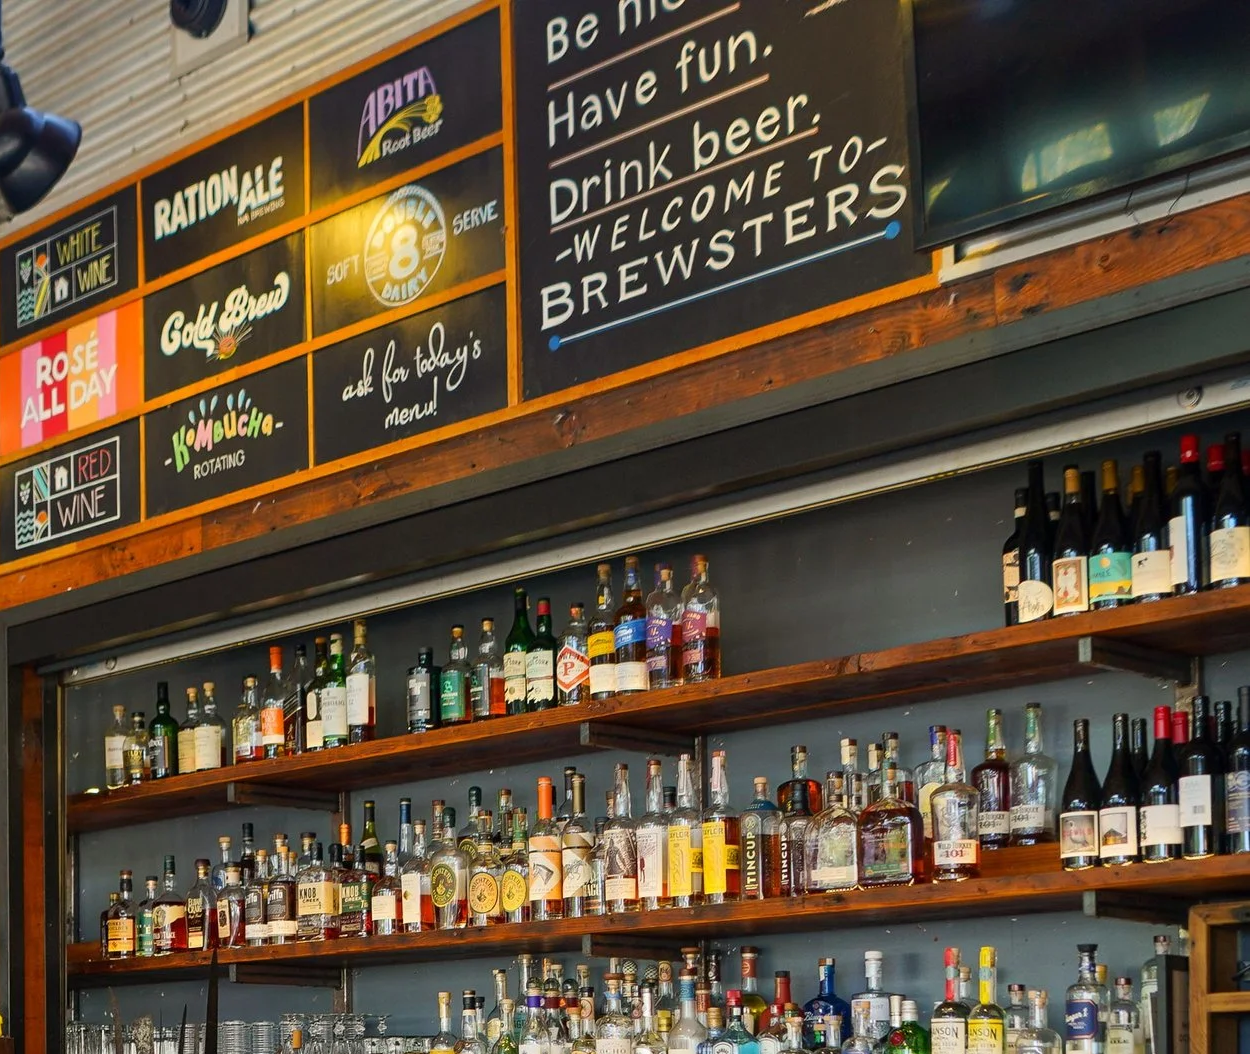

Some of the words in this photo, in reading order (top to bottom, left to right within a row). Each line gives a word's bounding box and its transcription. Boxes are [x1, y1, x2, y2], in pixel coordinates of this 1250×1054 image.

[547, 13, 600, 65] Be
[548, 70, 658, 148] Have
[675, 29, 774, 94] fun.
[357, 66, 437, 161] ABITA
[382, 131, 411, 157] Root
[412, 118, 444, 144] Beer
[549, 140, 674, 225] Drink
[693, 93, 822, 173] beer.
[452, 199, 499, 236] SERVE
[55, 221, 103, 266] WHITE
[389, 223, 419, 280] 8
[540, 164, 909, 332] BREWSTERS
[76, 253, 113, 294] WINE
[326, 254, 360, 286] SOFT
[381, 266, 428, 301] DAIRY
[218, 271, 290, 333] Brew
[36, 331, 99, 386] ROSÉ
[342, 347, 375, 401] ask
[382, 339, 410, 403] for
[413, 321, 482, 391] today's
[20, 388, 65, 429] ALL
[69, 363, 119, 413] DAY
[385, 375, 438, 430] menu!
[76, 447, 112, 482] RED
[193, 449, 245, 480] ROTATING
[56, 485, 107, 529] WINE
[669, 831, 689, 839] AYLOR
[703, 827, 724, 836] AYLOR
[746, 831, 756, 886] TINCUP
[944, 849, 964, 858] 101
[299, 887, 317, 899] KNOB
[342, 885, 359, 897] KNOB
[932, 1026, 959, 1039] ANSON
[968, 1027, 997, 1041] ANSON
